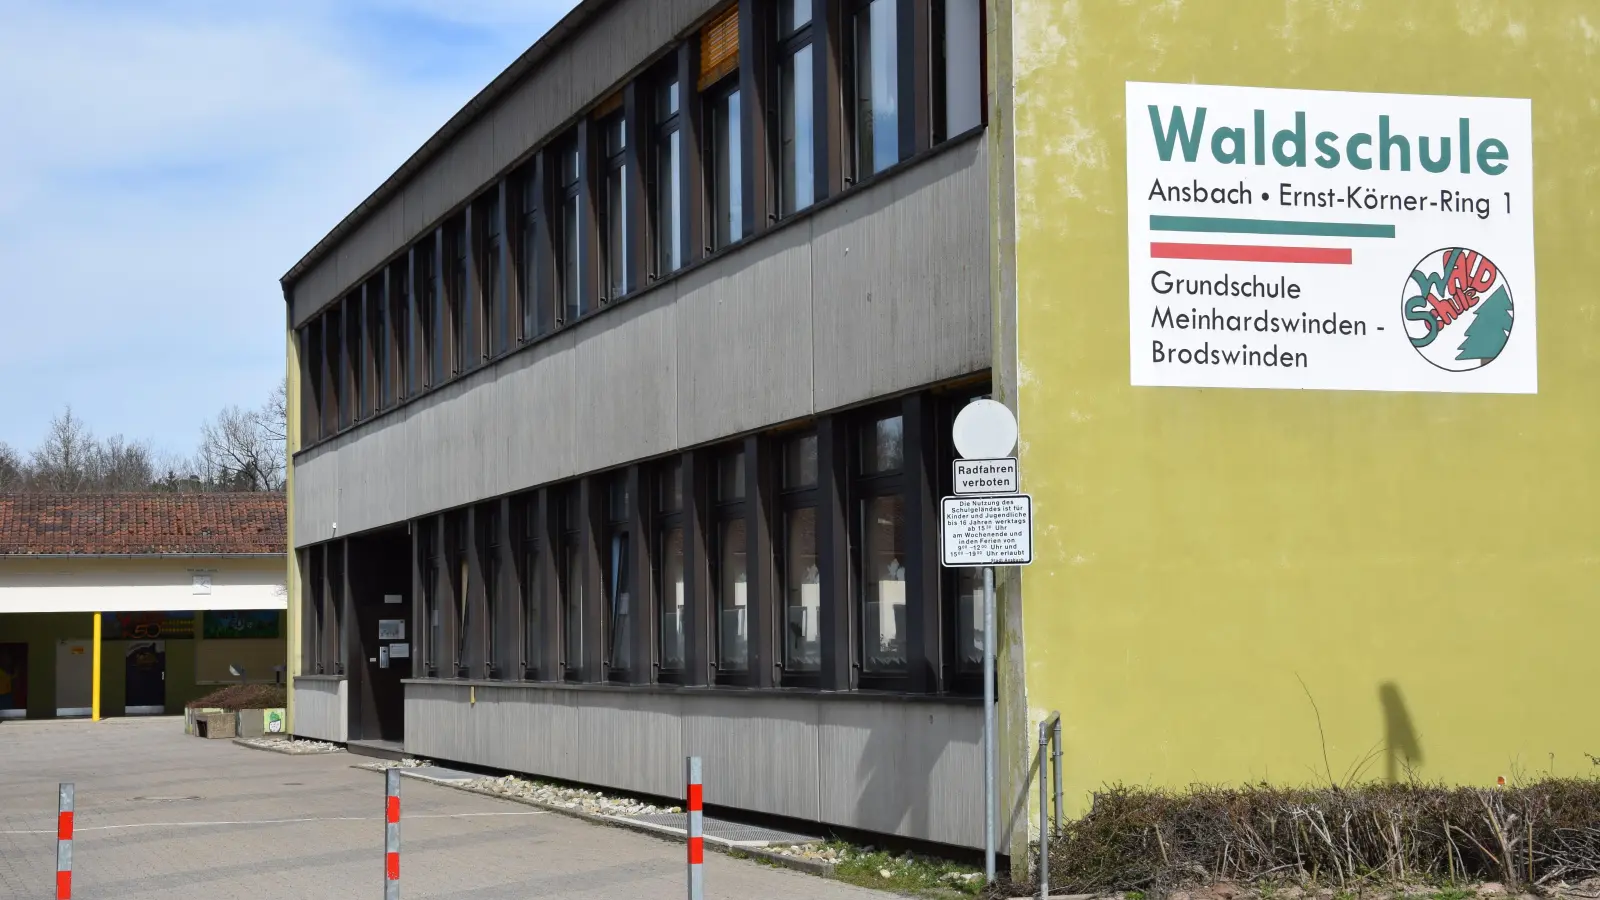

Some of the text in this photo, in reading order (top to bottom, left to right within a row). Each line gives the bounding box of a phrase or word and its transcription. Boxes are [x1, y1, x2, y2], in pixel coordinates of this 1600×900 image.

[1147, 104, 1509, 176] Waldschule
[1148, 178, 1512, 220] Ansbach Ernst-Körner-Ring 1
[1150, 270, 1302, 300] Grundschule
[1151, 305, 1367, 336] Meinhardswinden
[1152, 340, 1308, 368] Brodswinden
[958, 465, 1014, 475] Radfahren
[962, 478, 1010, 487] verboten
[951, 506, 1001, 514] Schulgeländes
[985, 511, 1027, 519] Jugendliche
